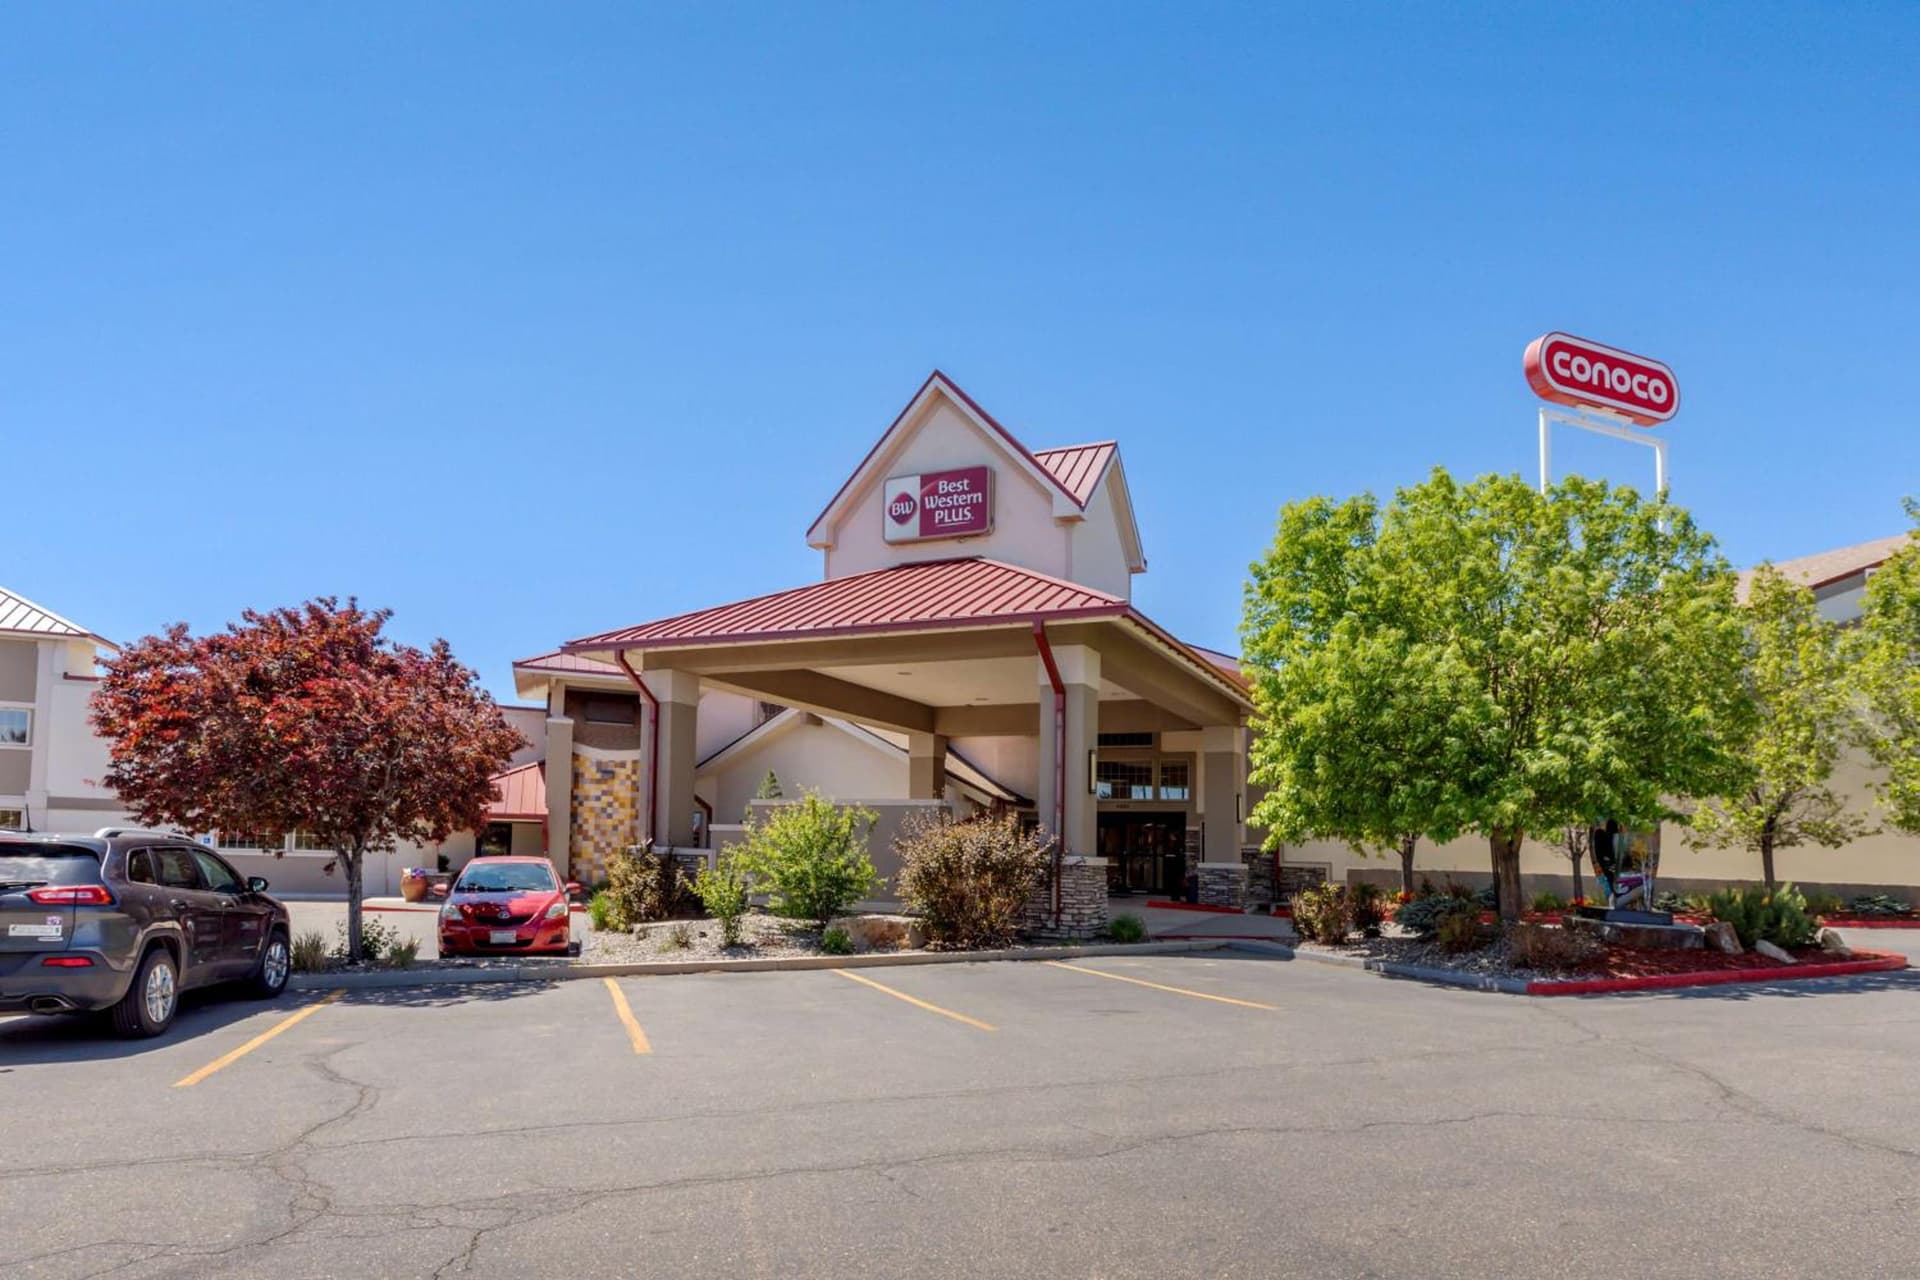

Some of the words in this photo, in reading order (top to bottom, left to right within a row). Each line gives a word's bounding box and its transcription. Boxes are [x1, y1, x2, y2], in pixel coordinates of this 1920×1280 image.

[938, 479, 969, 494] Best
[892, 501, 914, 516] BW
[925, 492, 982, 510] Western
[934, 507, 971, 524] PLUS
